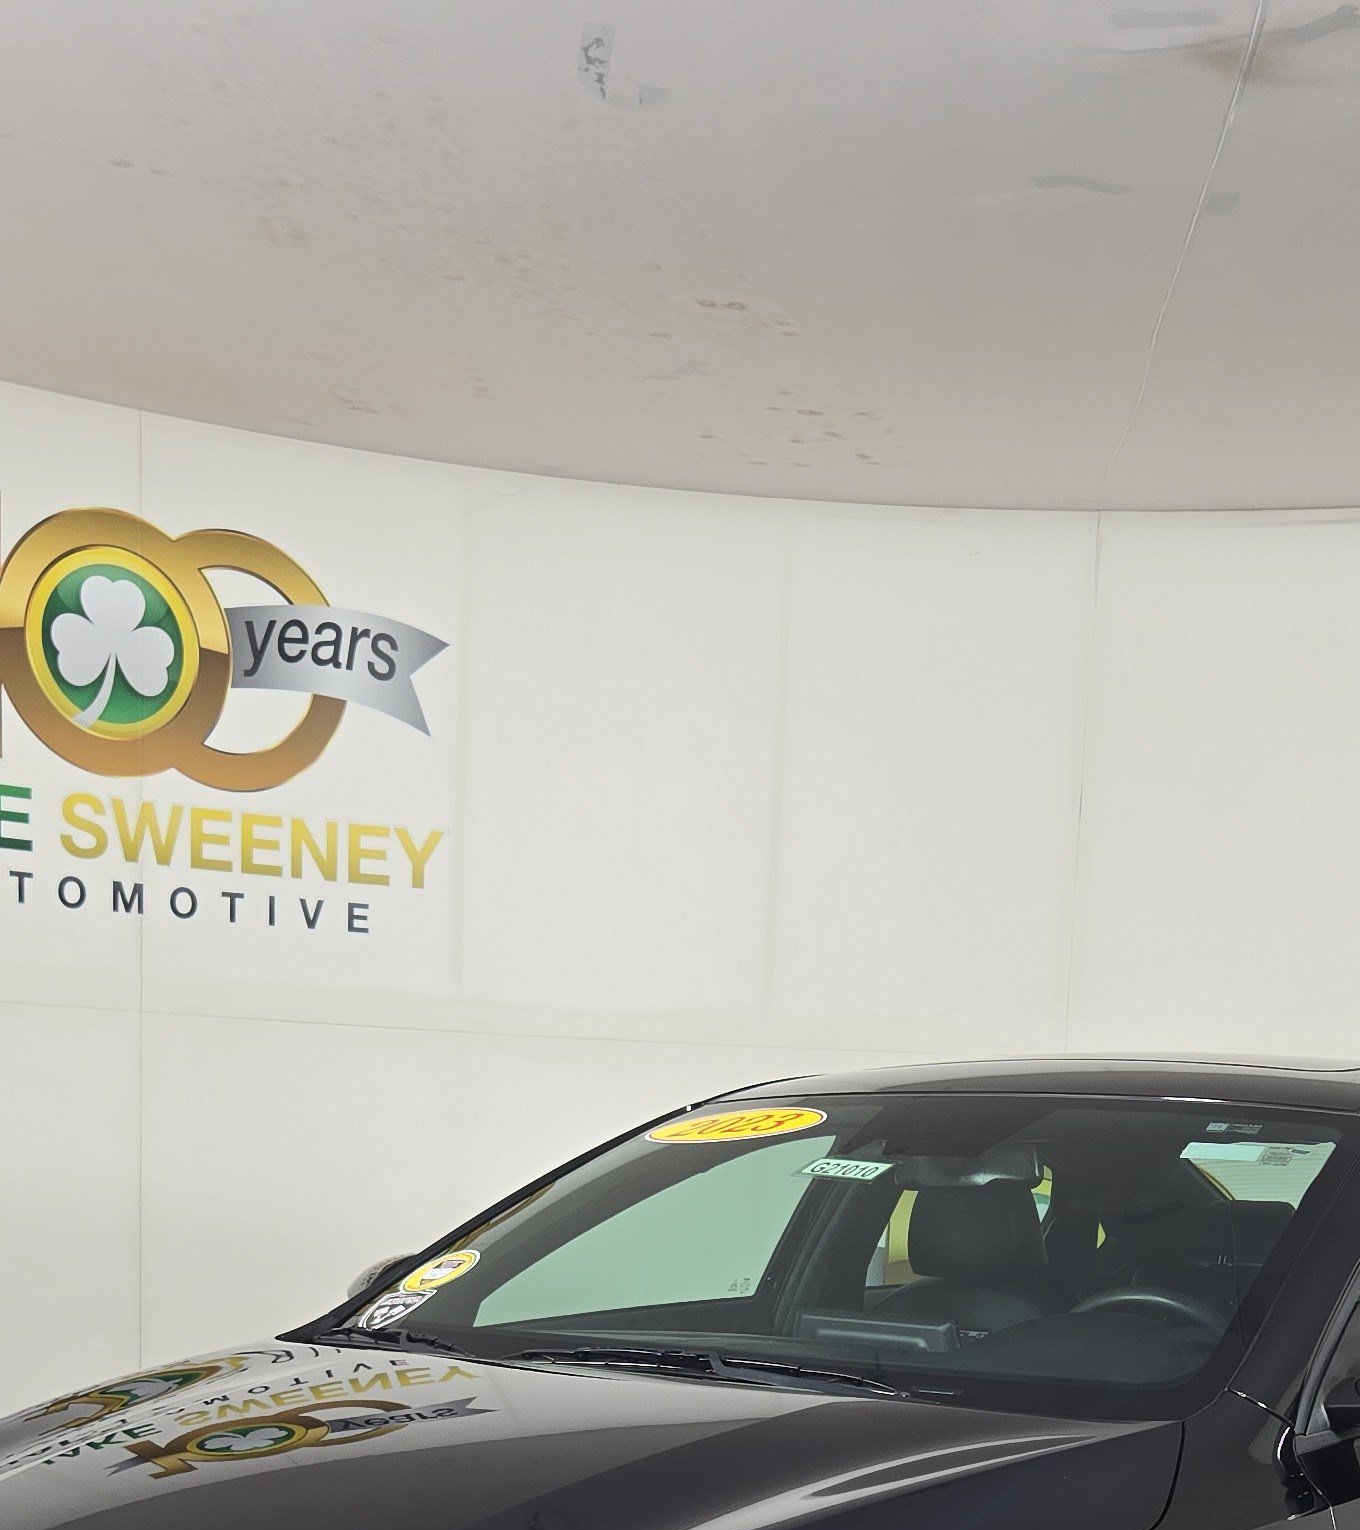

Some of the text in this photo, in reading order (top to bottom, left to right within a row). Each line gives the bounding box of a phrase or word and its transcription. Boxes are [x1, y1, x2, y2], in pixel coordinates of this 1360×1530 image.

[242, 617, 400, 682] years
[59, 792, 444, 889] SWEENEY
[664, 1113, 804, 1139] 2023
[809, 1161, 880, 1179] G21010
